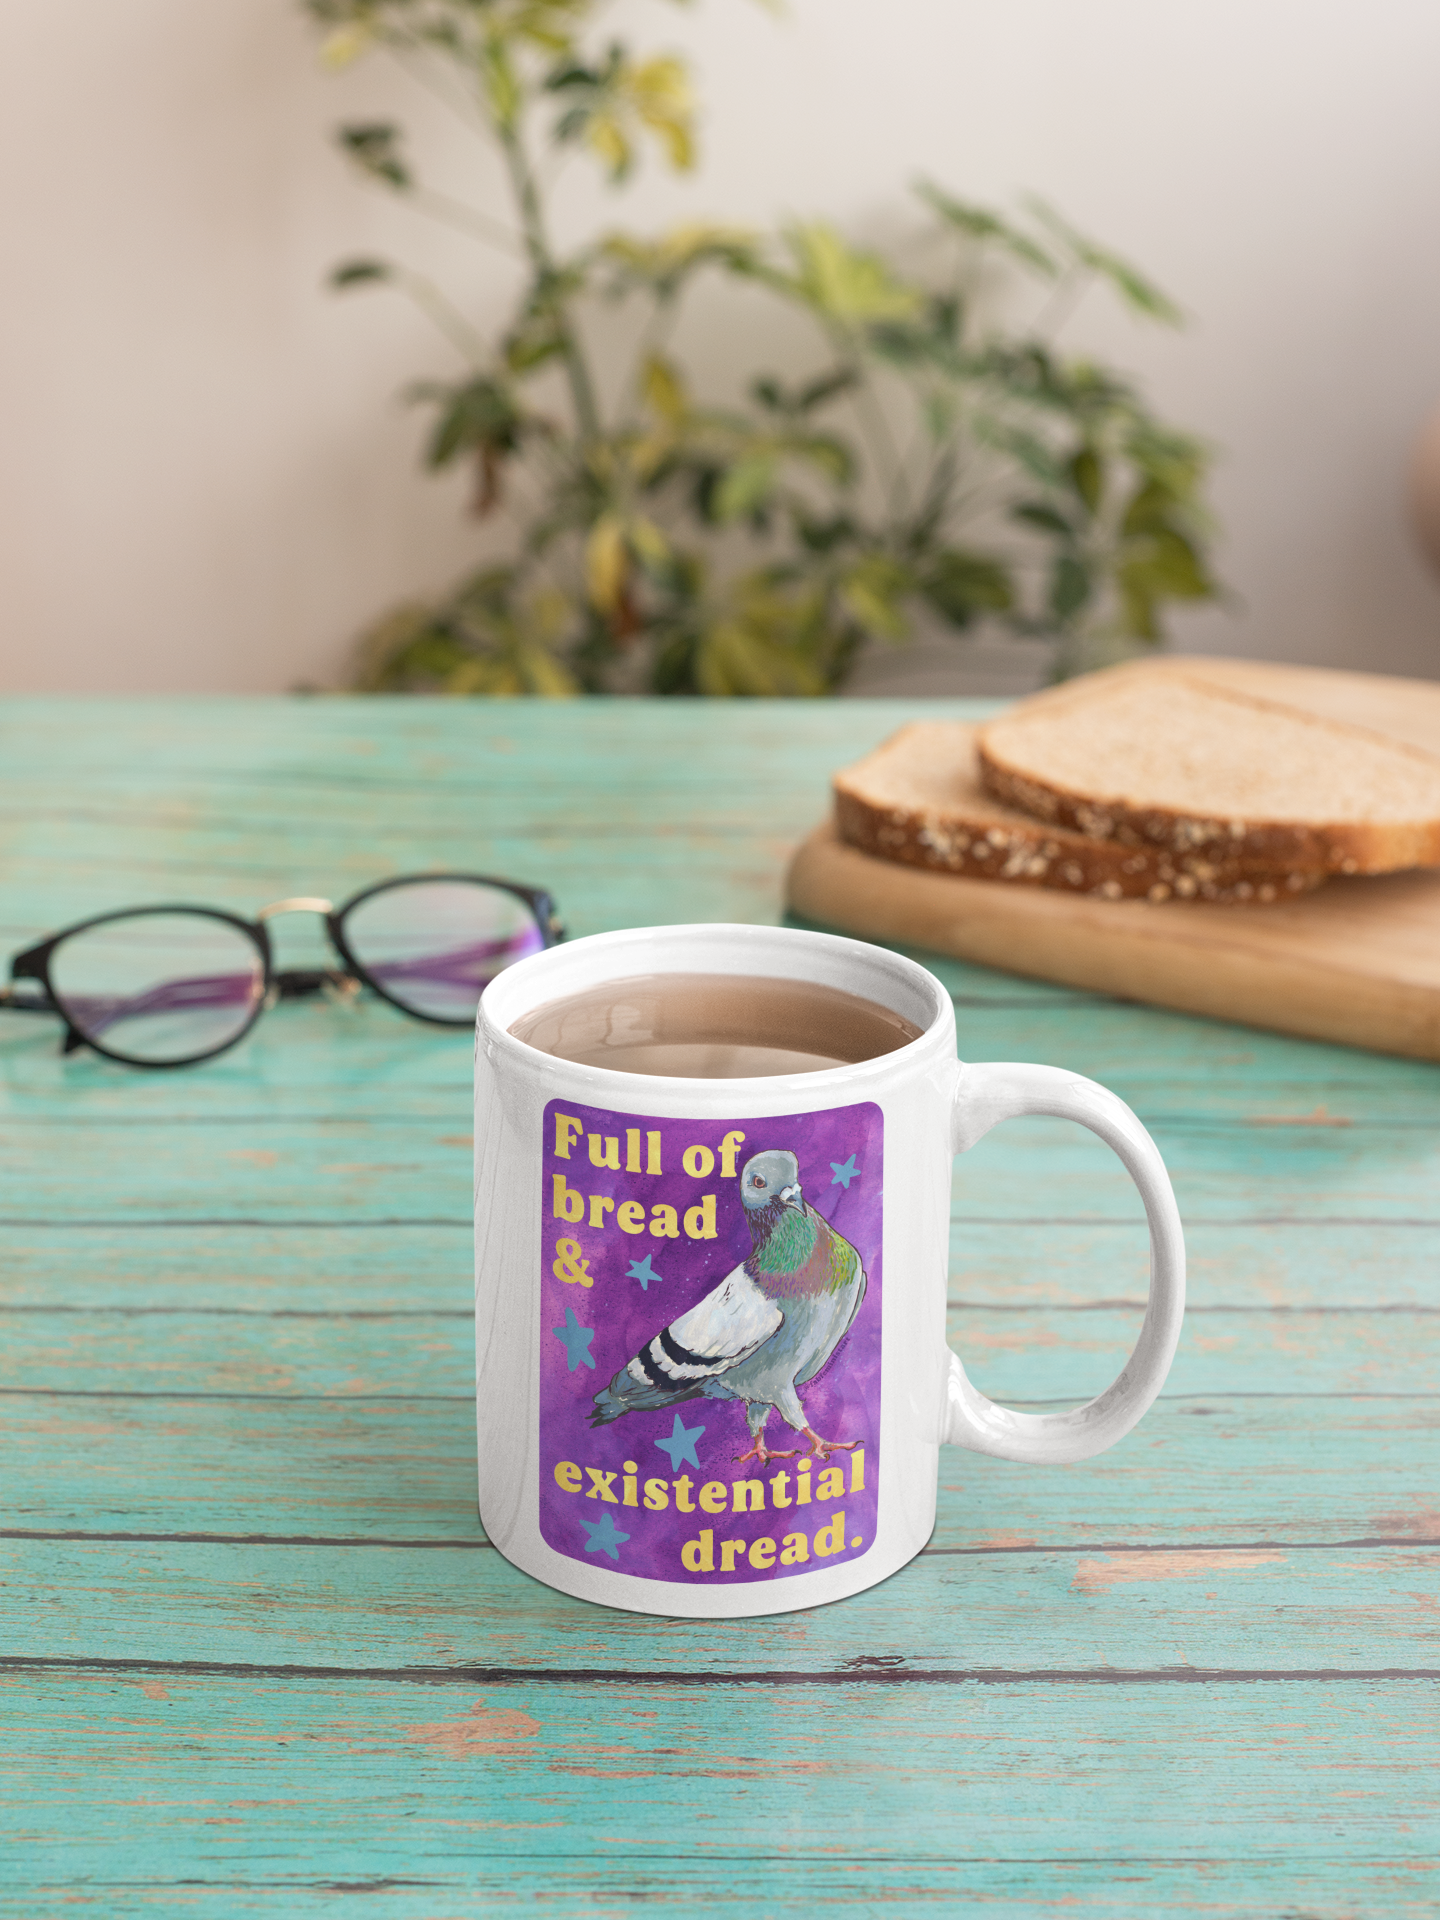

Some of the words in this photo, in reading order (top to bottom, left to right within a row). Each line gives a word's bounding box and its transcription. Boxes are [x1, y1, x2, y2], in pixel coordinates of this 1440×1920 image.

[553, 1112, 663, 1176] Full
[682, 1131, 746, 1179] of
[552, 1173, 719, 1240] bread
[552, 1237, 594, 1288] &
[554, 1448, 866, 1513] existential
[681, 1510, 863, 1572] dread.
